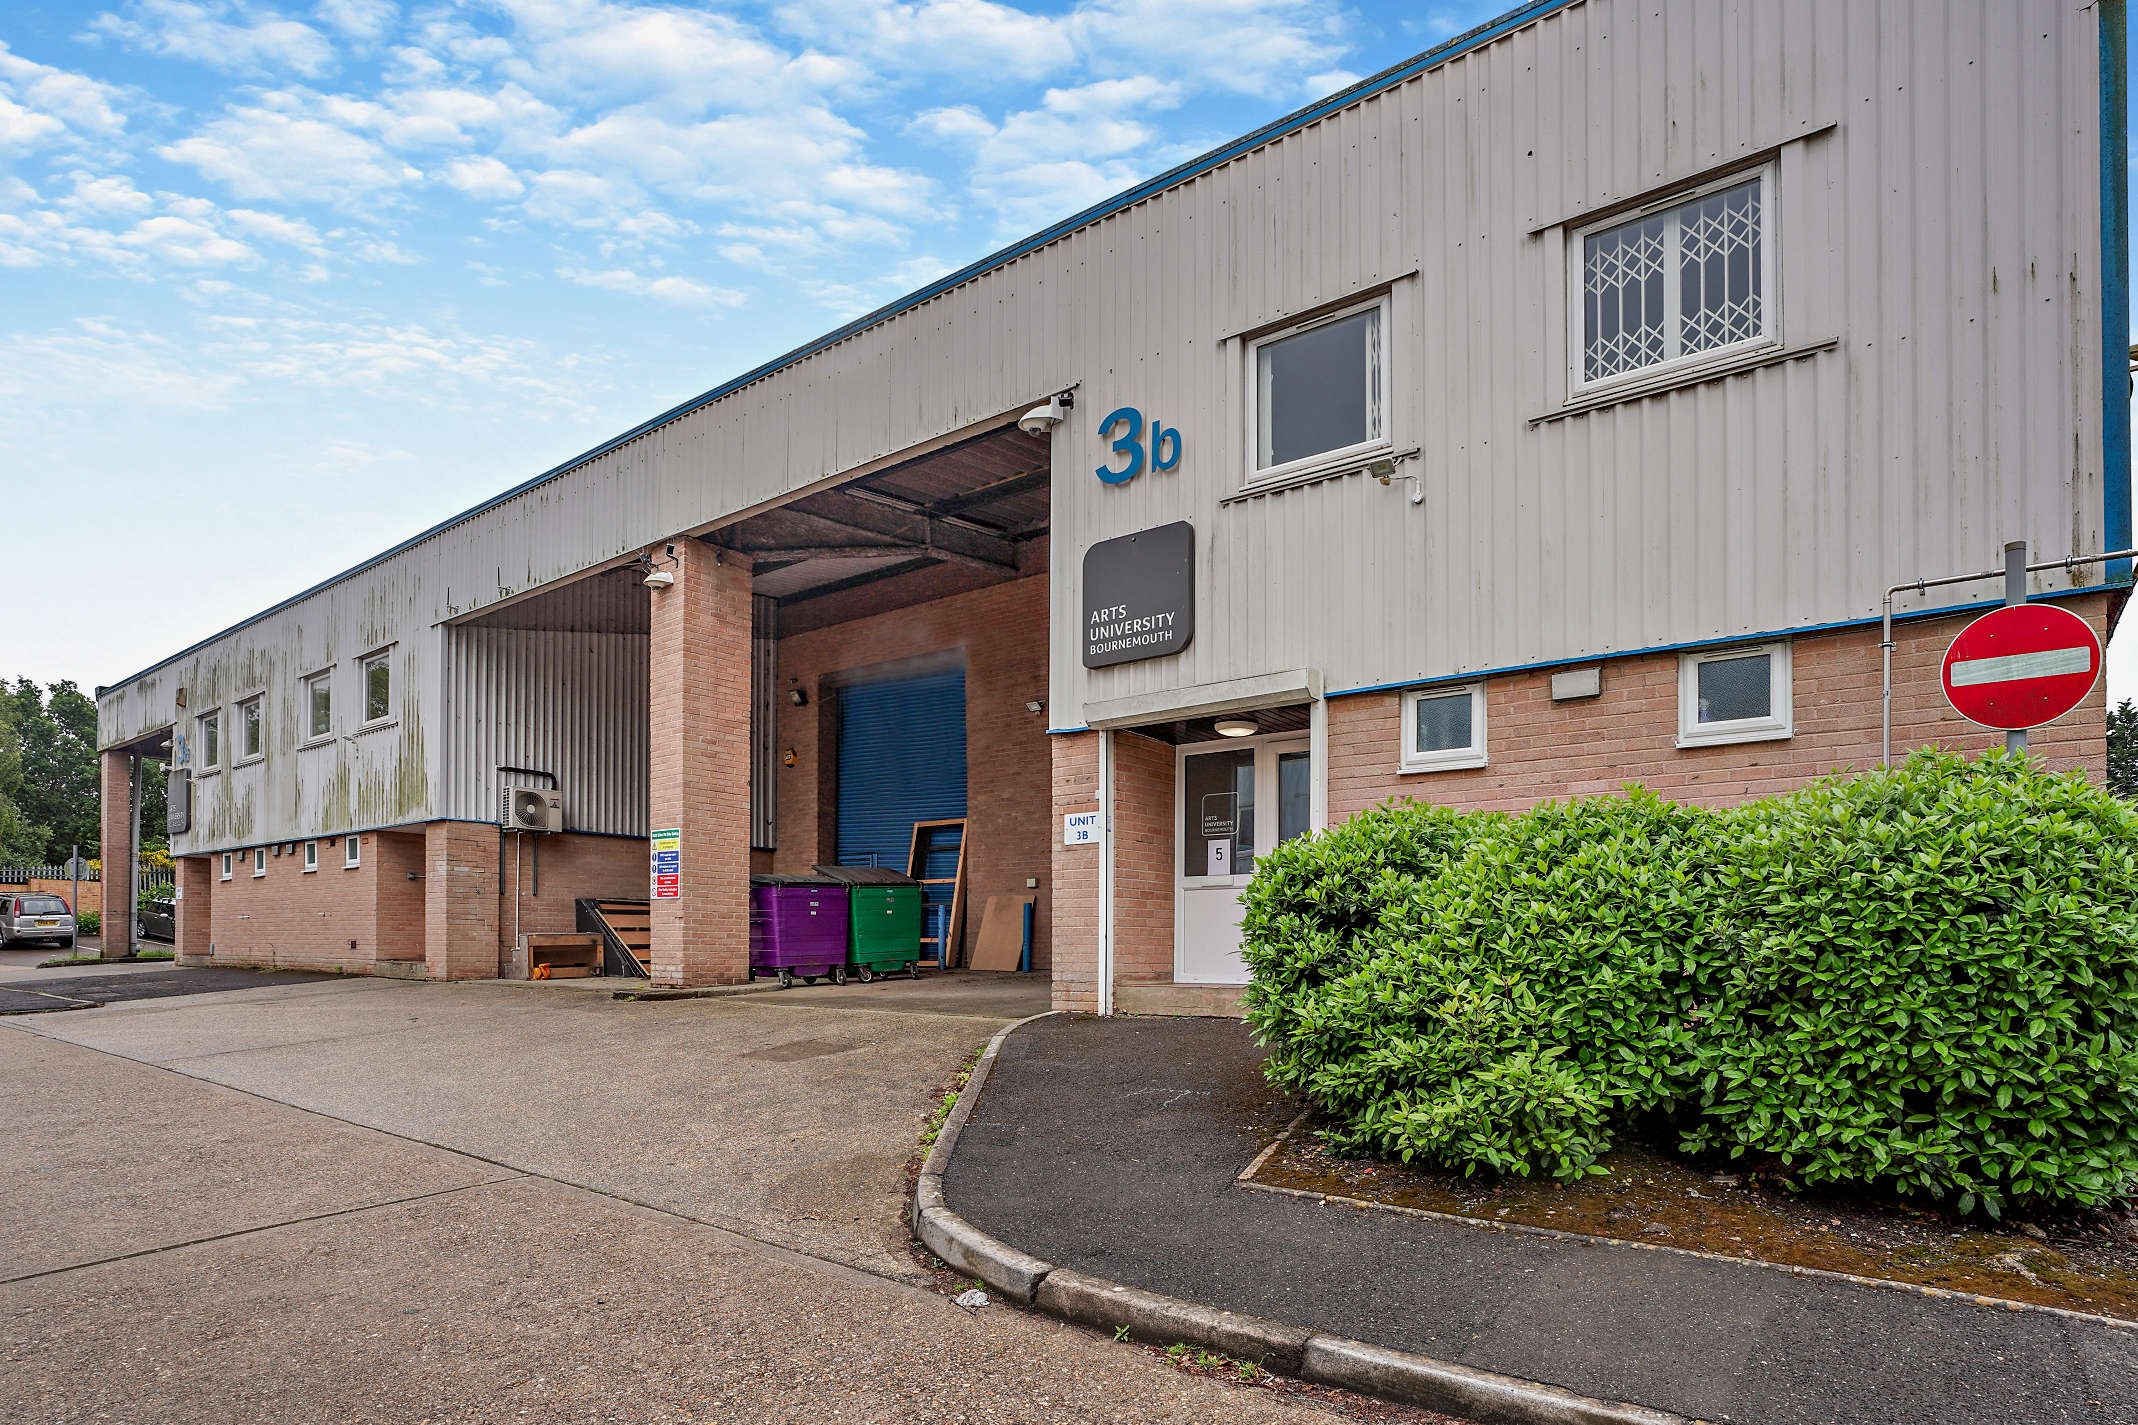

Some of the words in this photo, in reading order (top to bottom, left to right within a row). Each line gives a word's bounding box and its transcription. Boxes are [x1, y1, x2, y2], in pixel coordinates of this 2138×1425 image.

[1095, 407, 1182, 484] 3b
[1090, 604, 1127, 625] ARTS
[1090, 611, 1175, 641] UNIVERSITY
[1090, 630, 1173, 655] BOURNEMOUTH
[1069, 815, 1097, 827] UNIT
[1204, 820, 1234, 828] UNIVERSITY
[1076, 830, 1089, 841] 3B
[1215, 847, 1223, 861] 5
